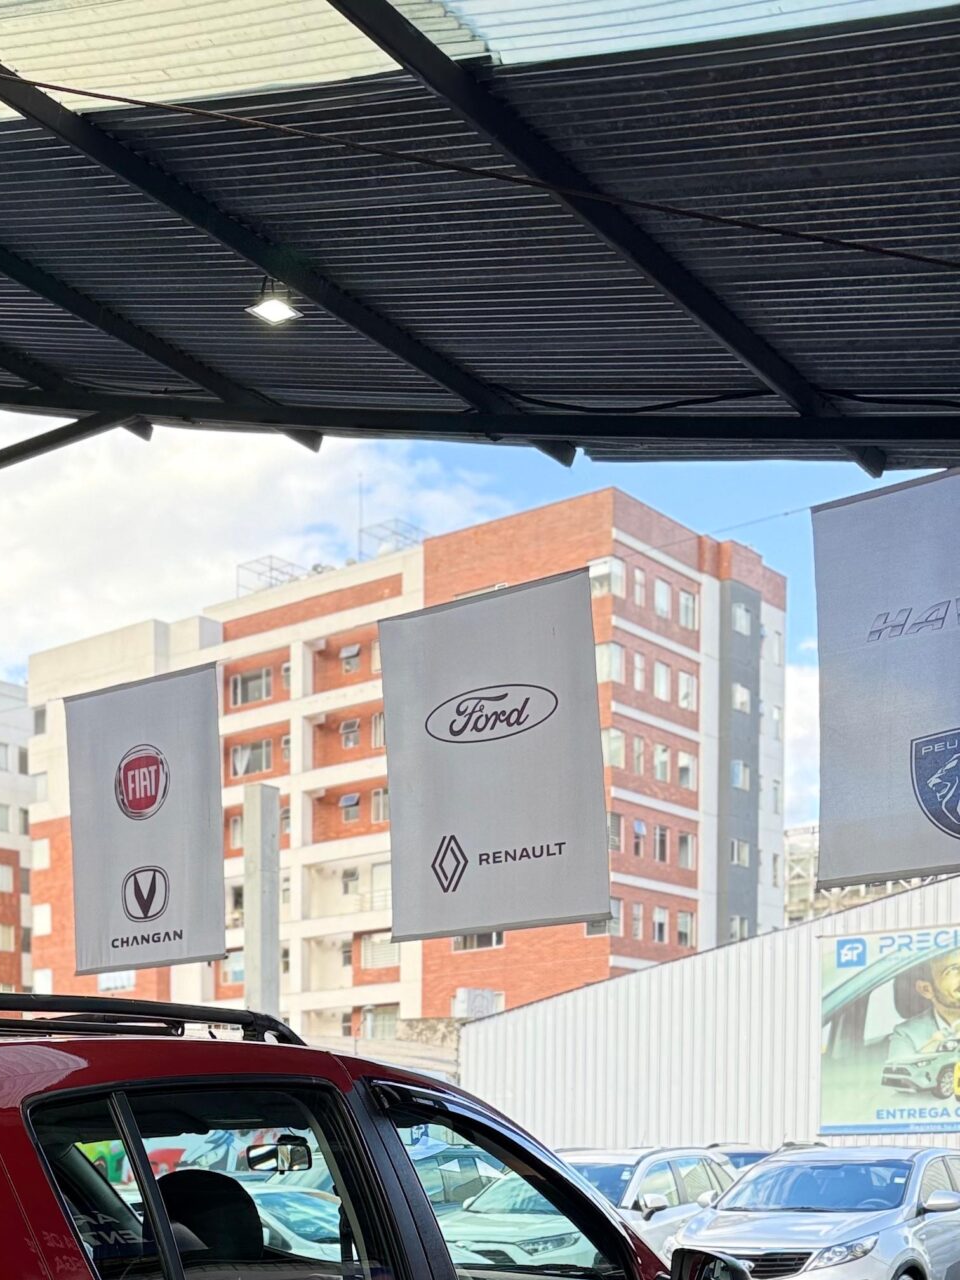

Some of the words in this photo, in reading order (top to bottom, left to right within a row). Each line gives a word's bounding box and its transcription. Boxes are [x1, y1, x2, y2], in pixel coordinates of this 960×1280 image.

[867, 597, 960, 643] HA
[448, 692, 530, 737] Ford
[127, 766, 158, 803] FIAT
[478, 841, 567, 866] RENAULT
[111, 929, 184, 949] CHANGAN
[879, 929, 959, 954] PRECI
[876, 1107, 951, 1120] ENTREGA
